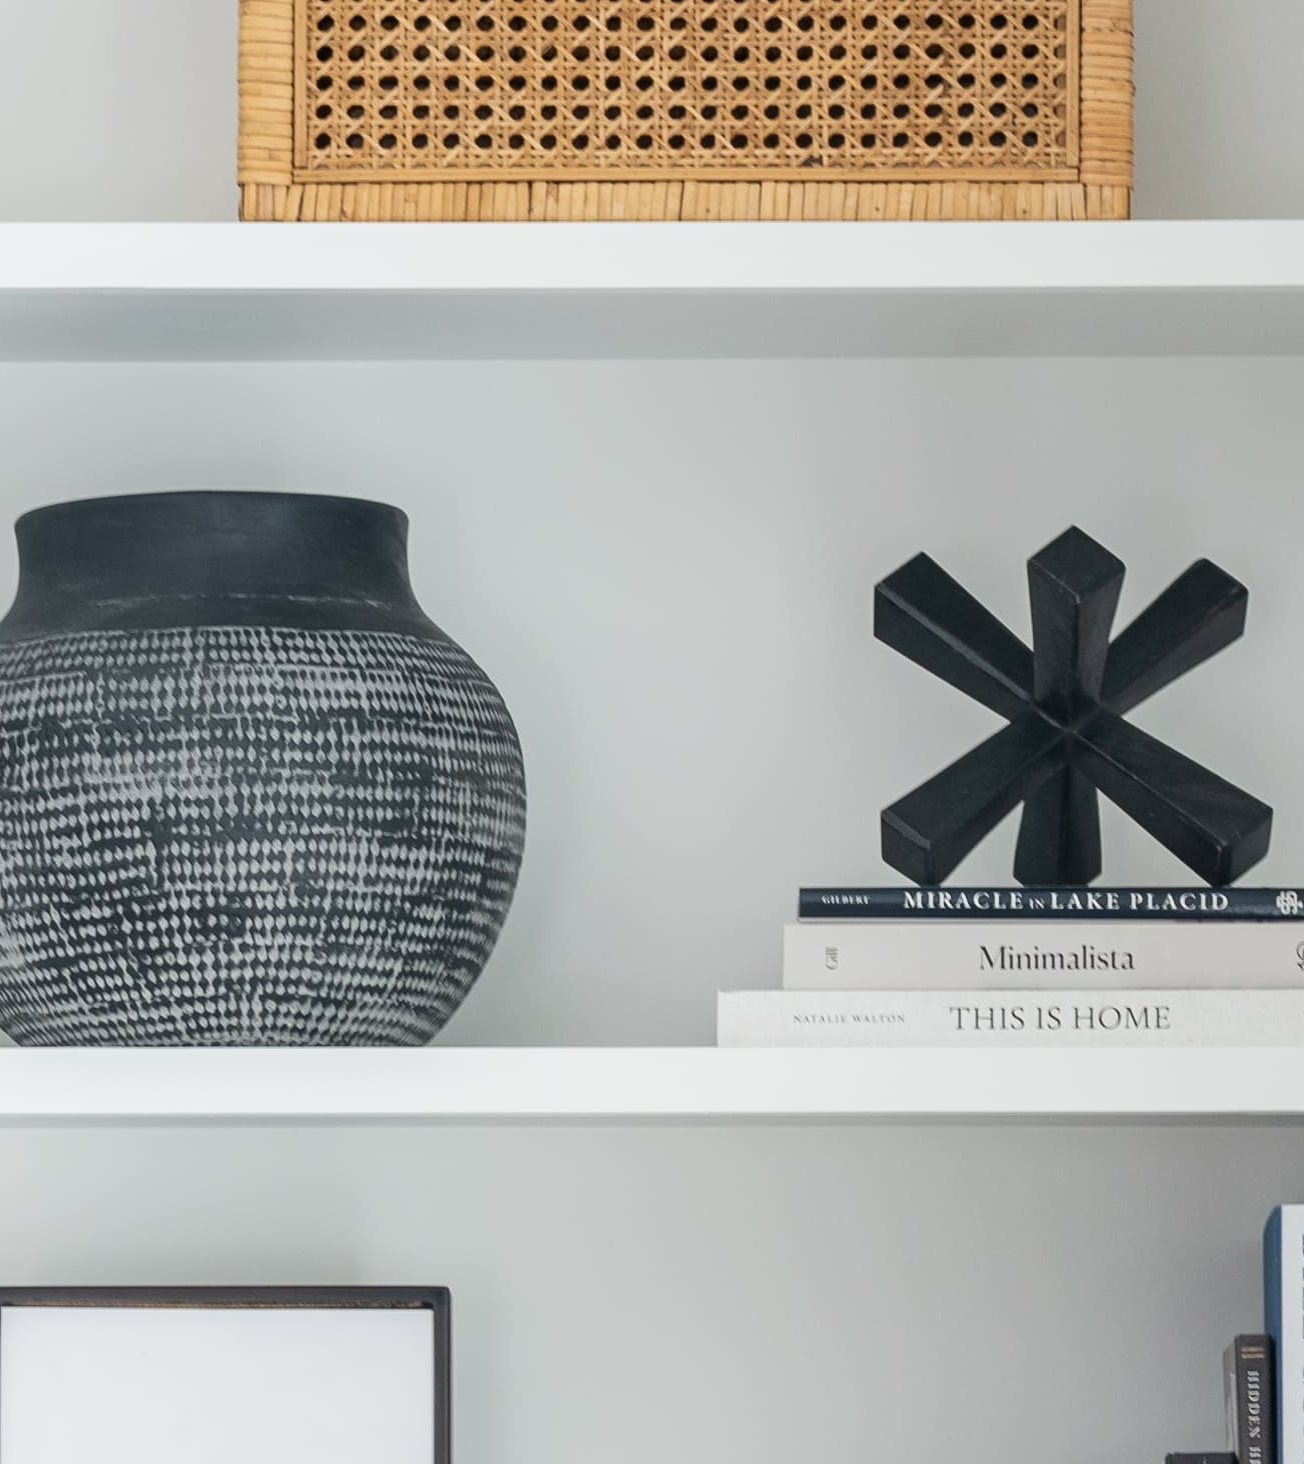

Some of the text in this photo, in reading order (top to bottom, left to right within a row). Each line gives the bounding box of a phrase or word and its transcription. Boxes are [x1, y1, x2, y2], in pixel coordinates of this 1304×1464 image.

[821, 894, 871, 905] GILBERT
[903, 891, 1024, 910] MIRACLE
[1051, 891, 1120, 911] LAKE
[1128, 891, 1229, 911] PLACID
[979, 944, 1135, 971] Minimalista
[793, 1014, 906, 1024] NATALIE WALTON
[949, 1006, 1171, 1031] THIS IS HOME
[1247, 1370, 1261, 1438] HIDDEN
